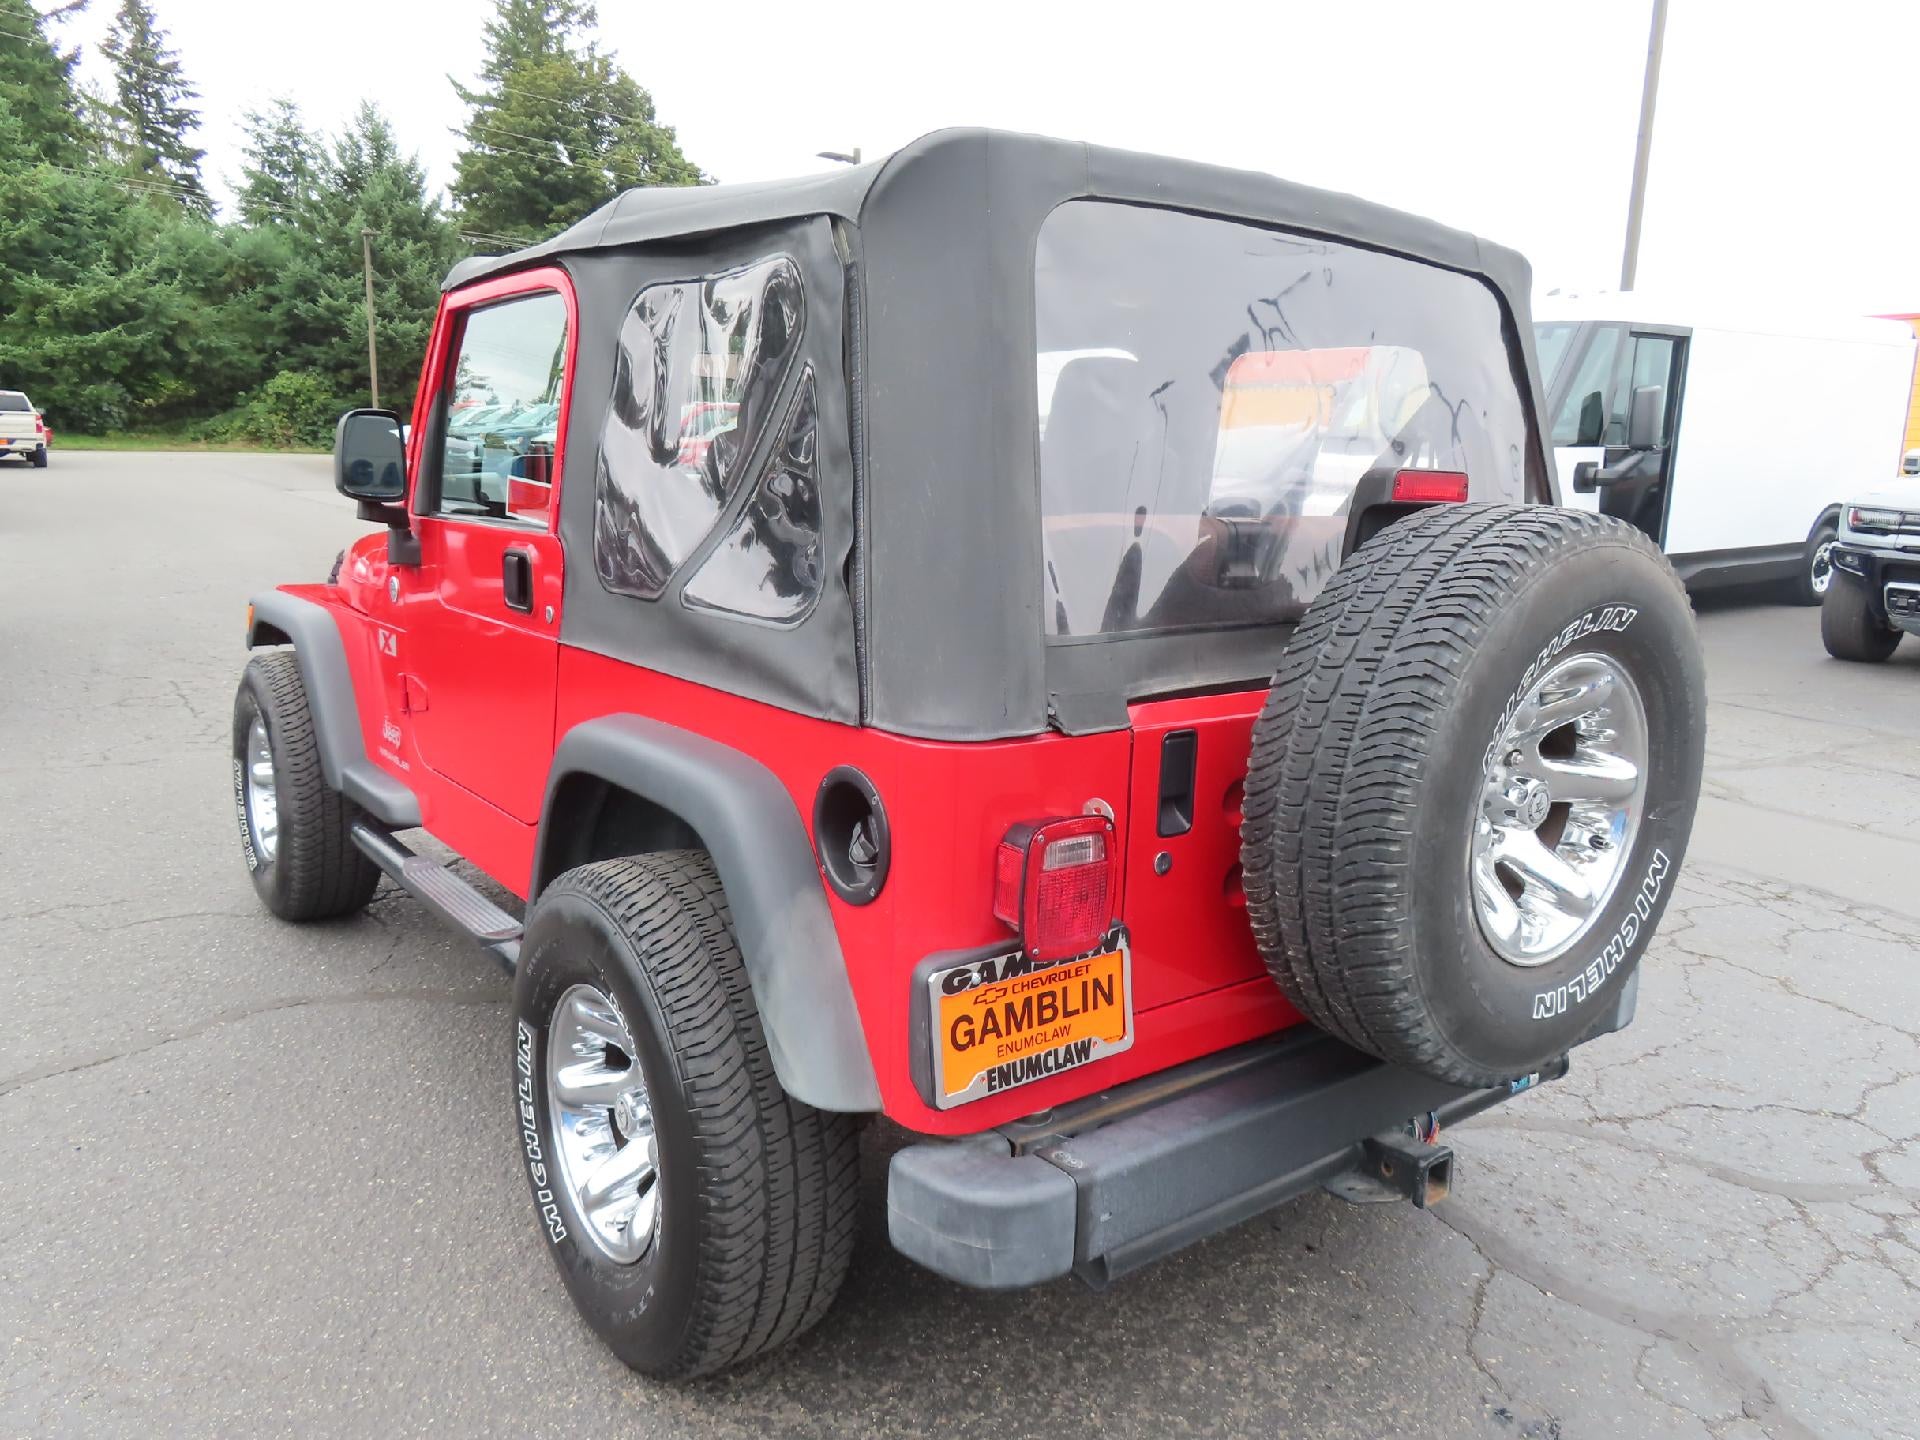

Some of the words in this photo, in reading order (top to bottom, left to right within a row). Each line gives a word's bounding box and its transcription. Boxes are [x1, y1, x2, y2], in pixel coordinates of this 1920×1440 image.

[942, 929, 1123, 995] GAMN
[1532, 849, 1670, 1020] MICHELIN
[1012, 963, 1091, 995] CHEVROLET
[950, 974, 1114, 1052] GAMBLIN
[997, 1023, 1071, 1057] ENUMCLAW
[986, 1037, 1092, 1092] ENUMCLAW
[518, 1016, 567, 1243] MICHELIN
